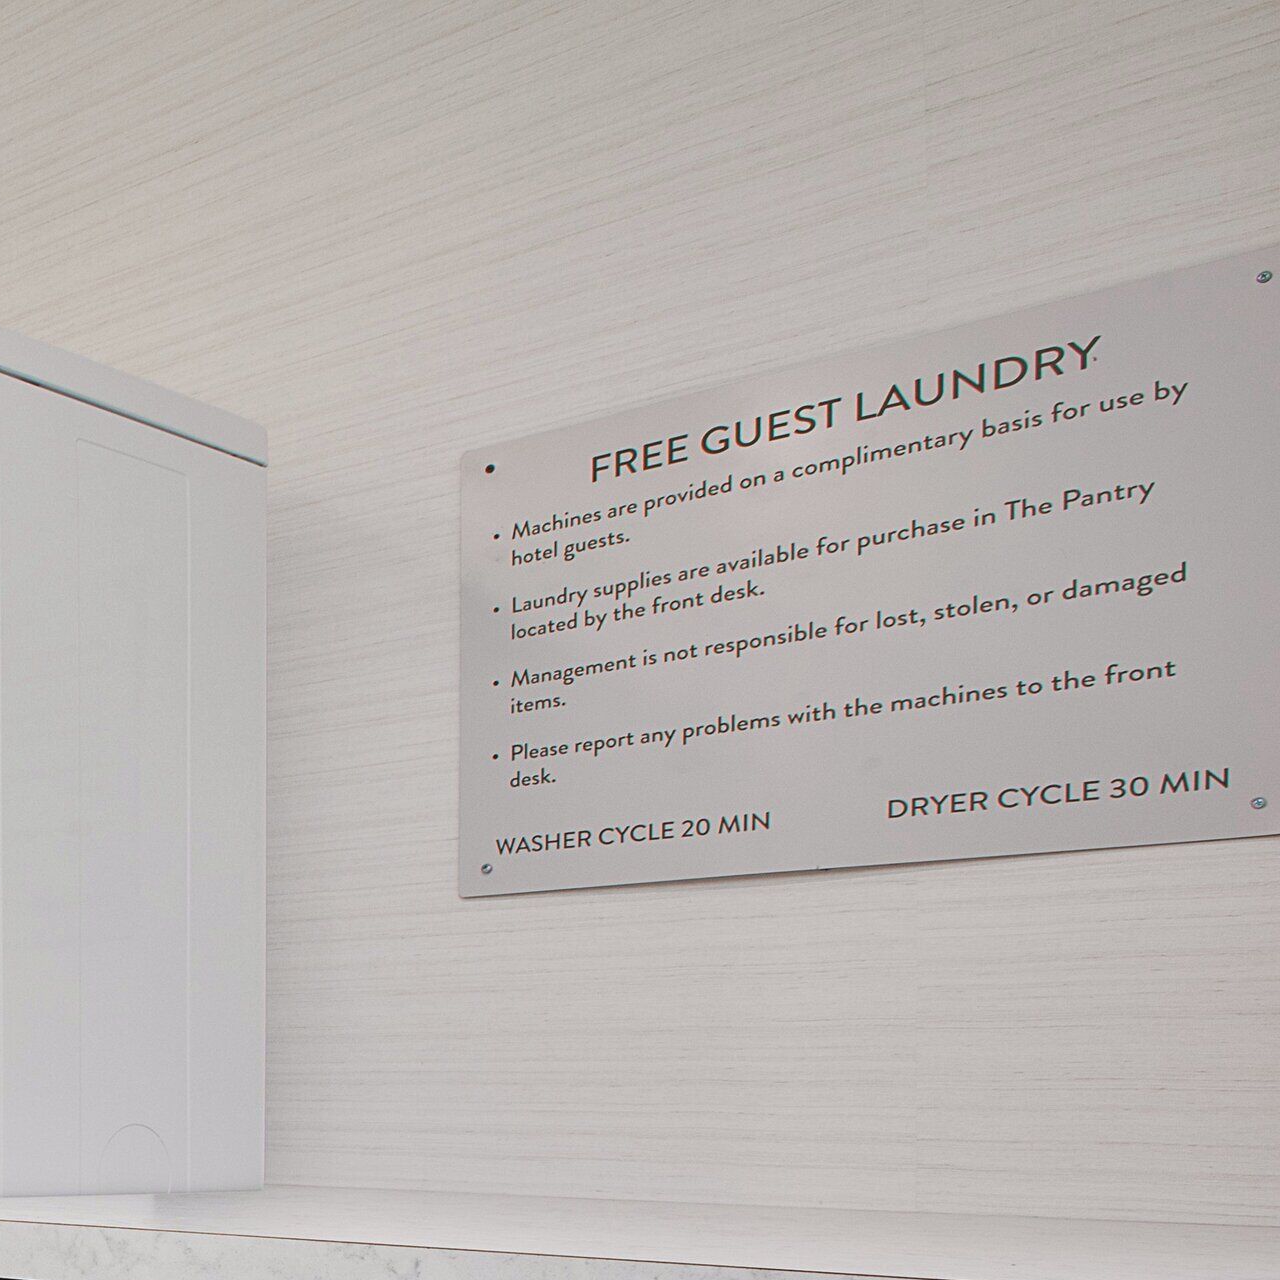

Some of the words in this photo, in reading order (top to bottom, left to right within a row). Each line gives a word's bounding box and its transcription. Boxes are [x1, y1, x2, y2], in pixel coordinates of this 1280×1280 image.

[591, 433, 689, 484] FREE
[700, 396, 843, 455] GUEST
[855, 334, 1102, 422] LAUNDRY
[511, 510, 602, 540] Machines
[607, 502, 638, 519] are
[643, 473, 733, 518] provided
[739, 474, 767, 490] on
[773, 470, 785, 483] a
[791, 428, 974, 479] complimentary
[981, 409, 1043, 439] basis
[1050, 401, 1092, 424] for
[1099, 392, 1145, 413] use
[1154, 380, 1189, 406] by
[511, 540, 558, 567] hotel
[563, 532, 631, 562] guests.
[512, 586, 589, 614] Laundry
[593, 570, 672, 601] supplies
[677, 565, 711, 582] are
[715, 542, 810, 575] available
[815, 535, 851, 556] for
[857, 518, 966, 557] purchase
[973, 507, 996, 528] in
[1003, 498, 1053, 521] The
[1062, 481, 1156, 511] Pantry
[510, 654, 637, 688] Management
[642, 648, 658, 667] is
[663, 644, 699, 663] not
[704, 620, 828, 659] responsible
[834, 615, 870, 636] for
[876, 609, 927, 630] lost,
[933, 594, 1019, 621] stolen,
[1026, 590, 1055, 606] or
[1061, 560, 1187, 601] damaged
[511, 611, 578, 641] located
[584, 609, 608, 632] by
[612, 602, 646, 622] the
[651, 592, 705, 615] front
[710, 579, 766, 604] desk.
[510, 696, 567, 715] items.
[511, 742, 569, 762] Please
[574, 732, 635, 758] report
[639, 728, 677, 749] any
[682, 713, 781, 746] problems
[787, 701, 837, 725] with
[843, 697, 884, 718] the
[890, 684, 1008, 713] machines
[1015, 680, 1044, 696] to
[1050, 670, 1097, 692] the
[1104, 661, 1177, 685] front
[509, 767, 557, 788] desk.
[887, 791, 989, 819] DRYER
[997, 779, 1101, 809] CYCLE
[1109, 776, 1150, 799] 30
[1159, 767, 1230, 795] MIN
[495, 829, 592, 856] WASHER
[598, 820, 675, 846] CYCLE
[680, 817, 711, 838] 20
[717, 811, 771, 835] MIN
